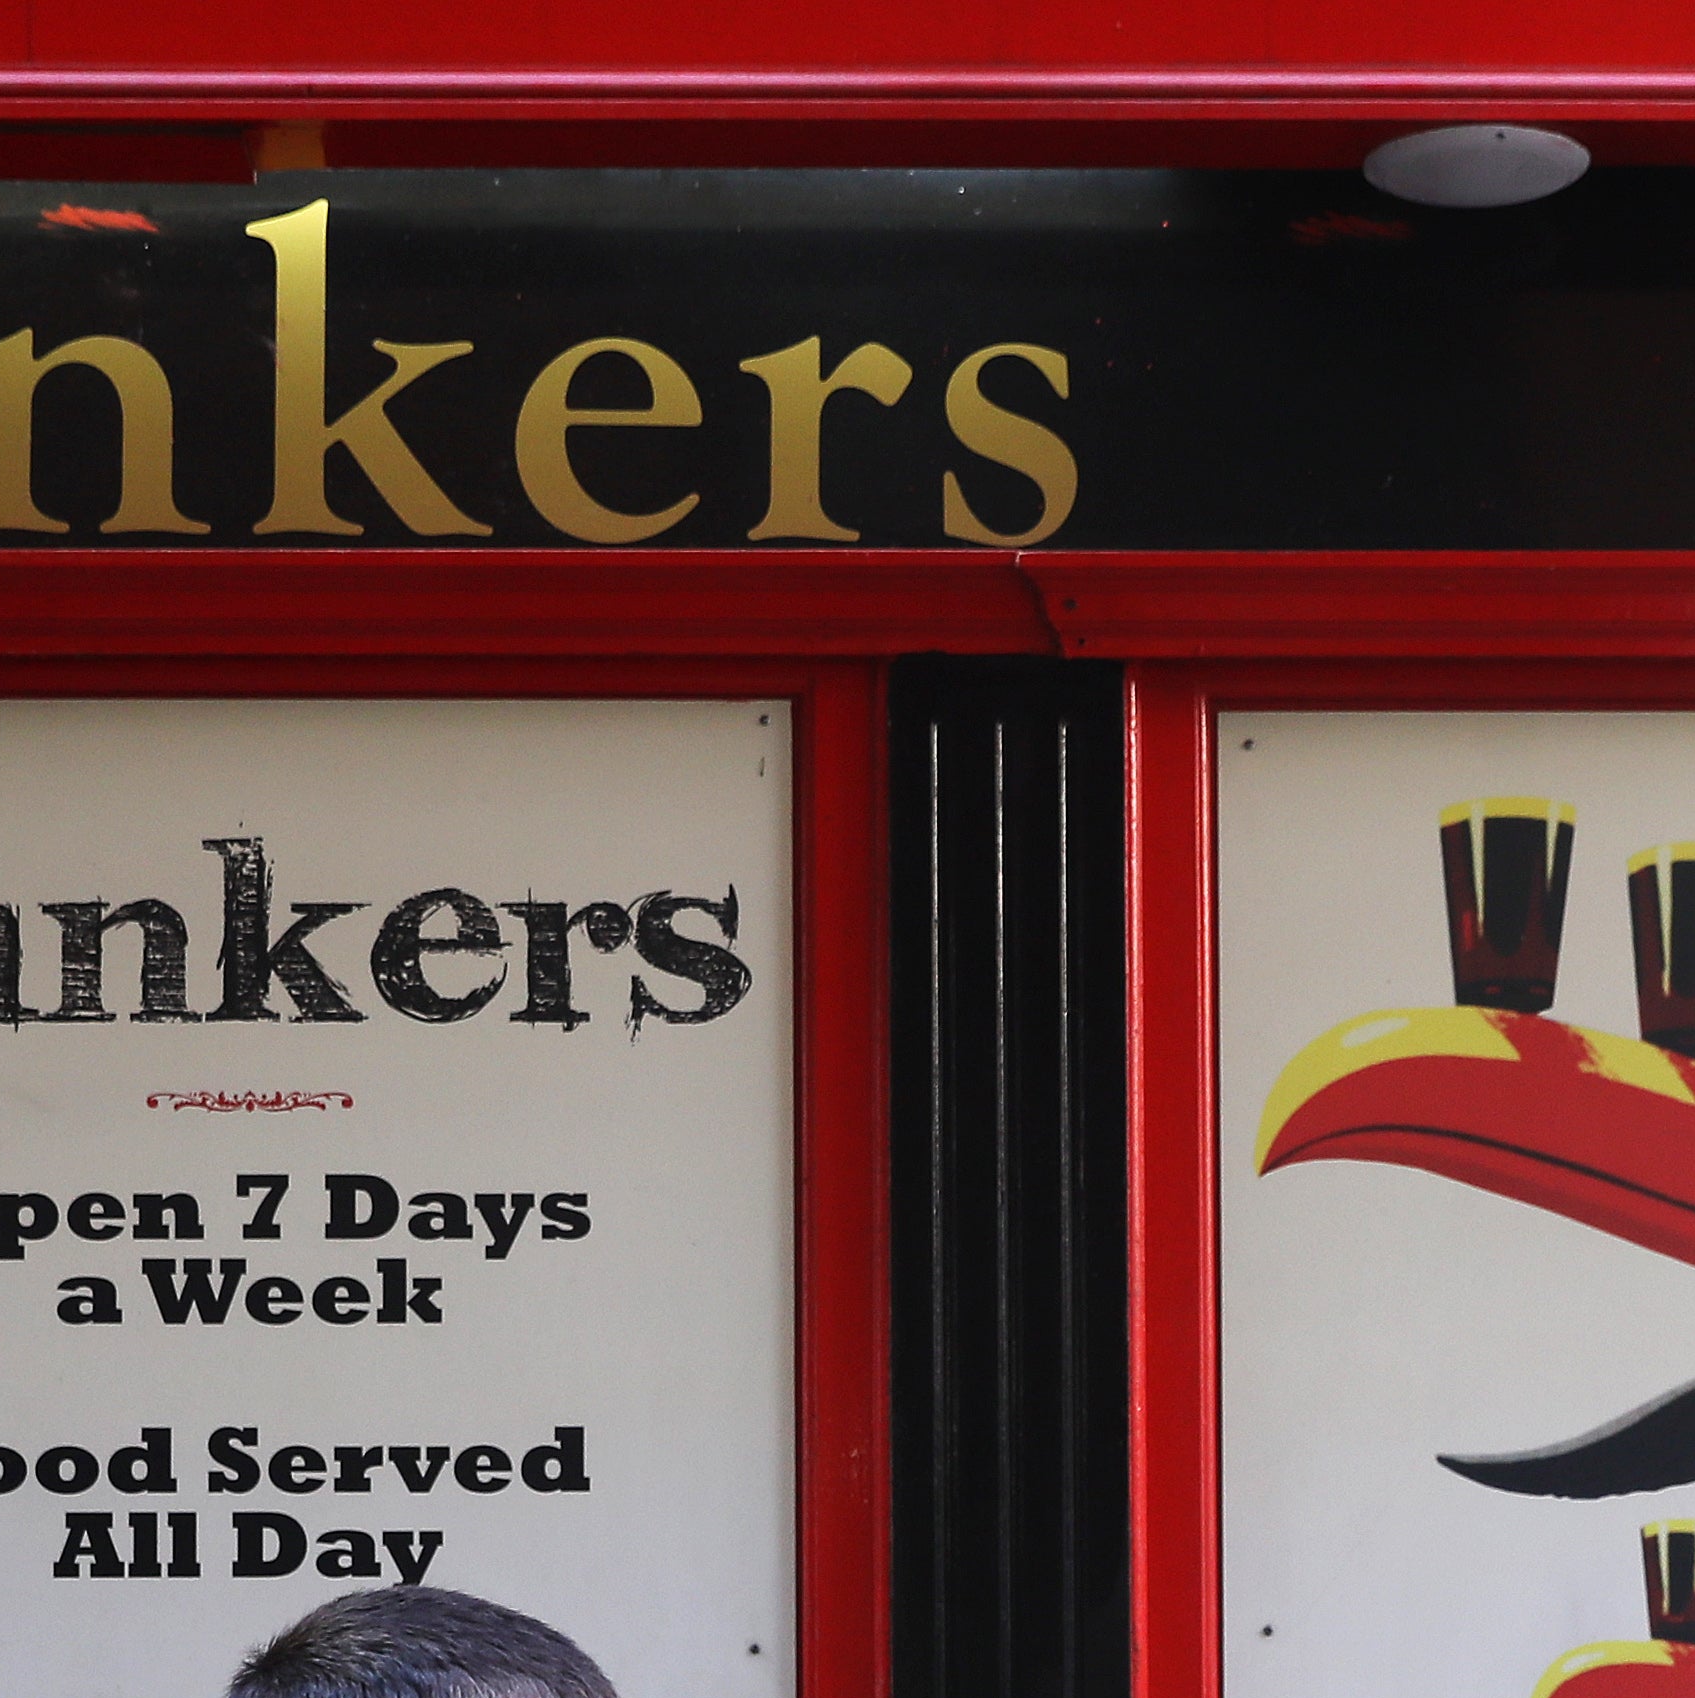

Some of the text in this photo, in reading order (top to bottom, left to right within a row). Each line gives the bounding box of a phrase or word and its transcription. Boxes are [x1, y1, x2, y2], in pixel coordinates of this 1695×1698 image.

[236, 1174, 289, 1240] 7
[324, 1174, 591, 1265] Days
[56, 1258, 442, 1325] a Week
[207, 1426, 591, 1494] Served
[53, 1511, 443, 1585] All Day
